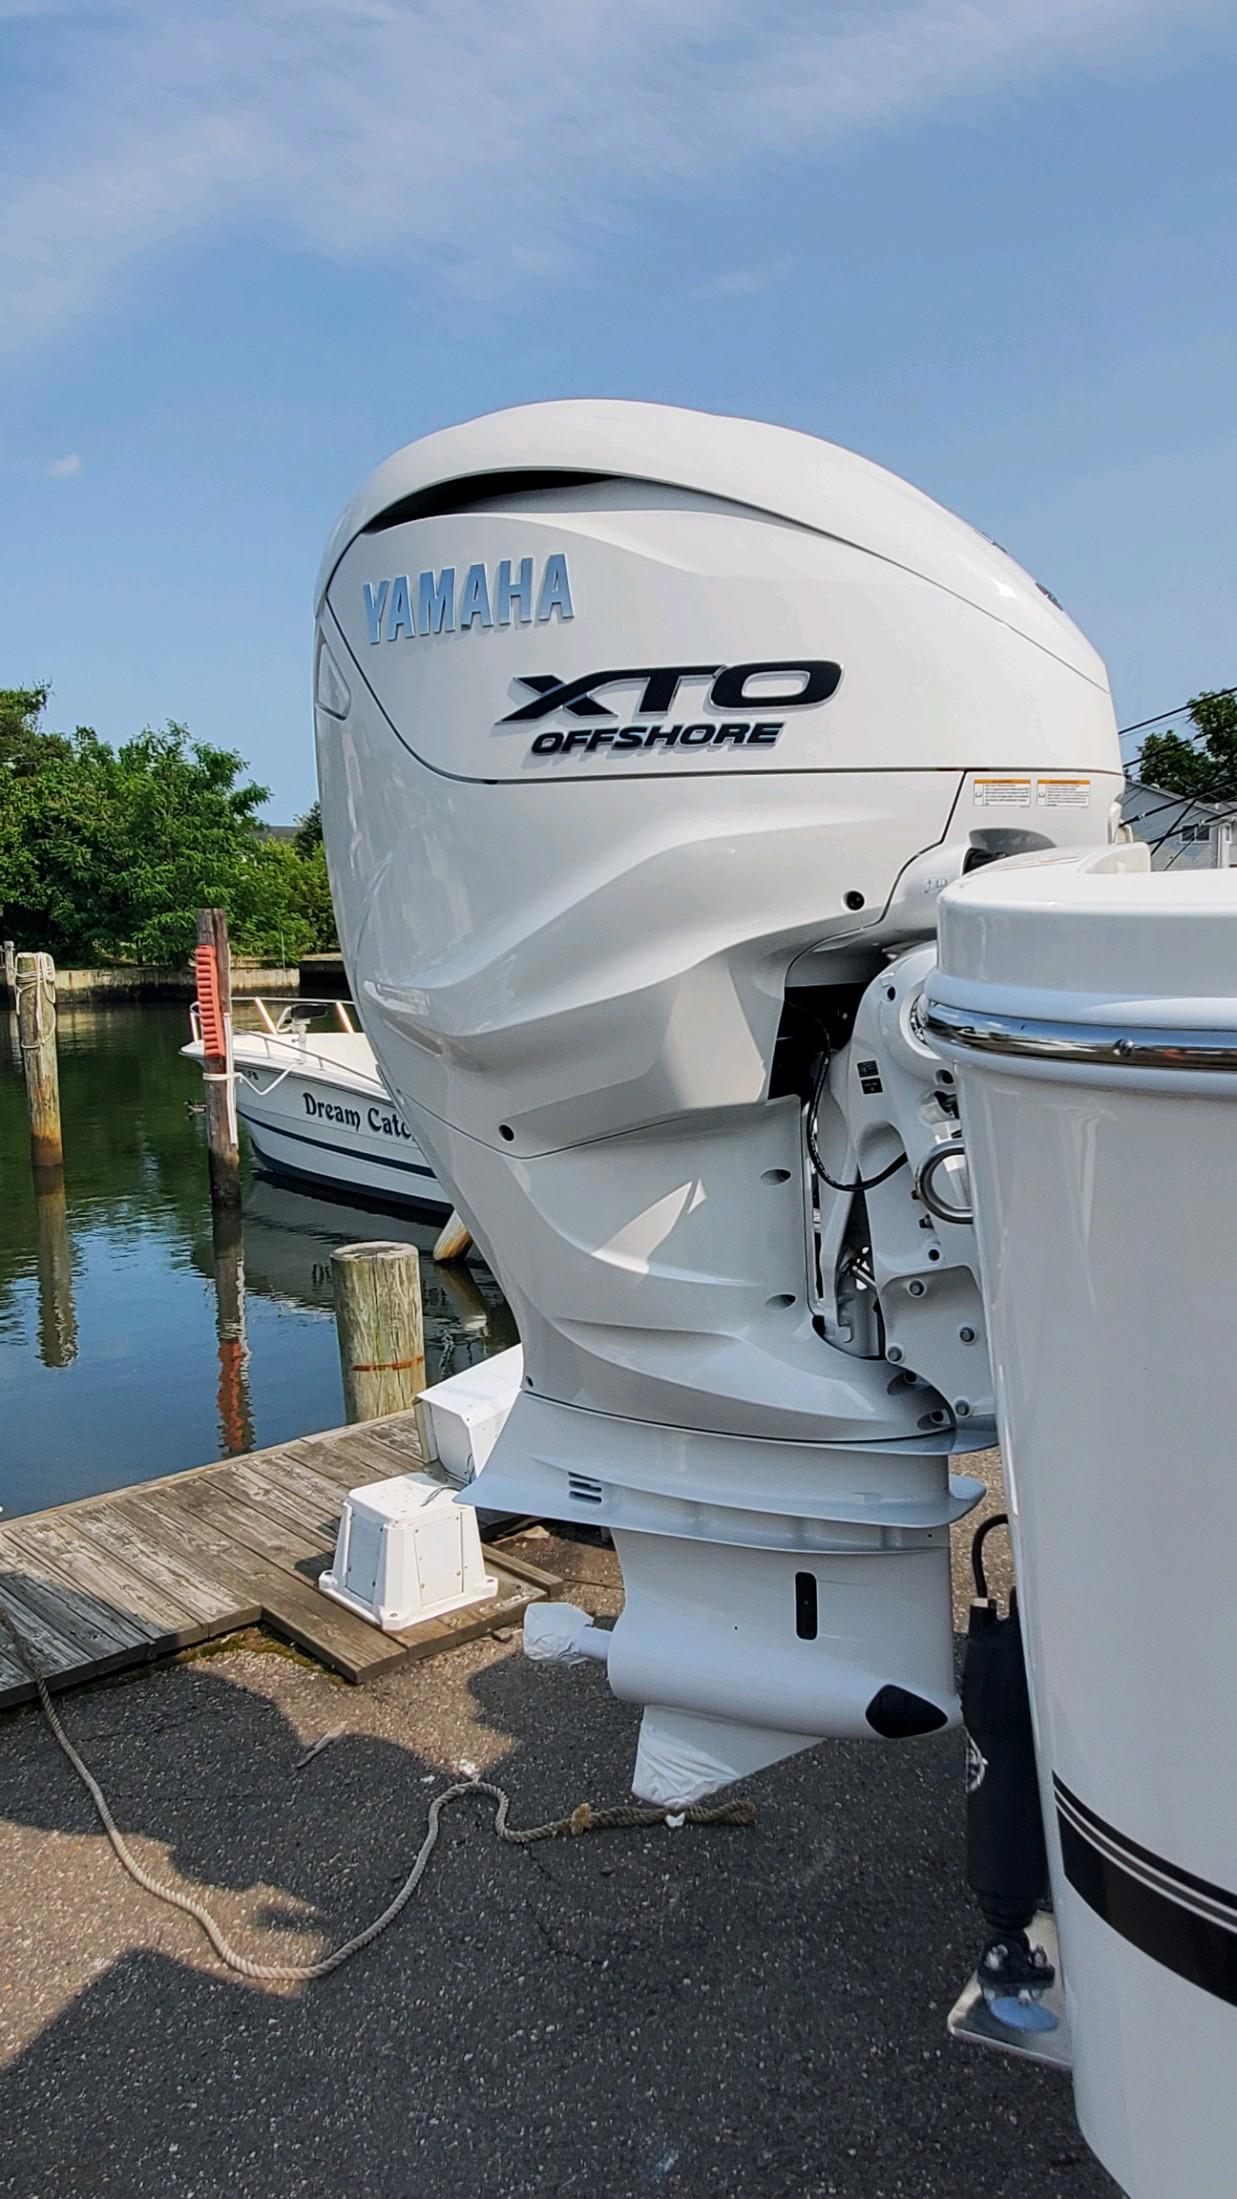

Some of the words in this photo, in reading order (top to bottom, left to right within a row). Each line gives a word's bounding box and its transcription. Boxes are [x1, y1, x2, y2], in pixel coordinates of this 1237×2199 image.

[362, 552, 575, 645] YAMAHA
[495, 658, 843, 726] XTO
[531, 721, 785, 756] OFFSHORE
[302, 1092, 361, 1132] Dream
[367, 1107, 415, 1141] Catc
